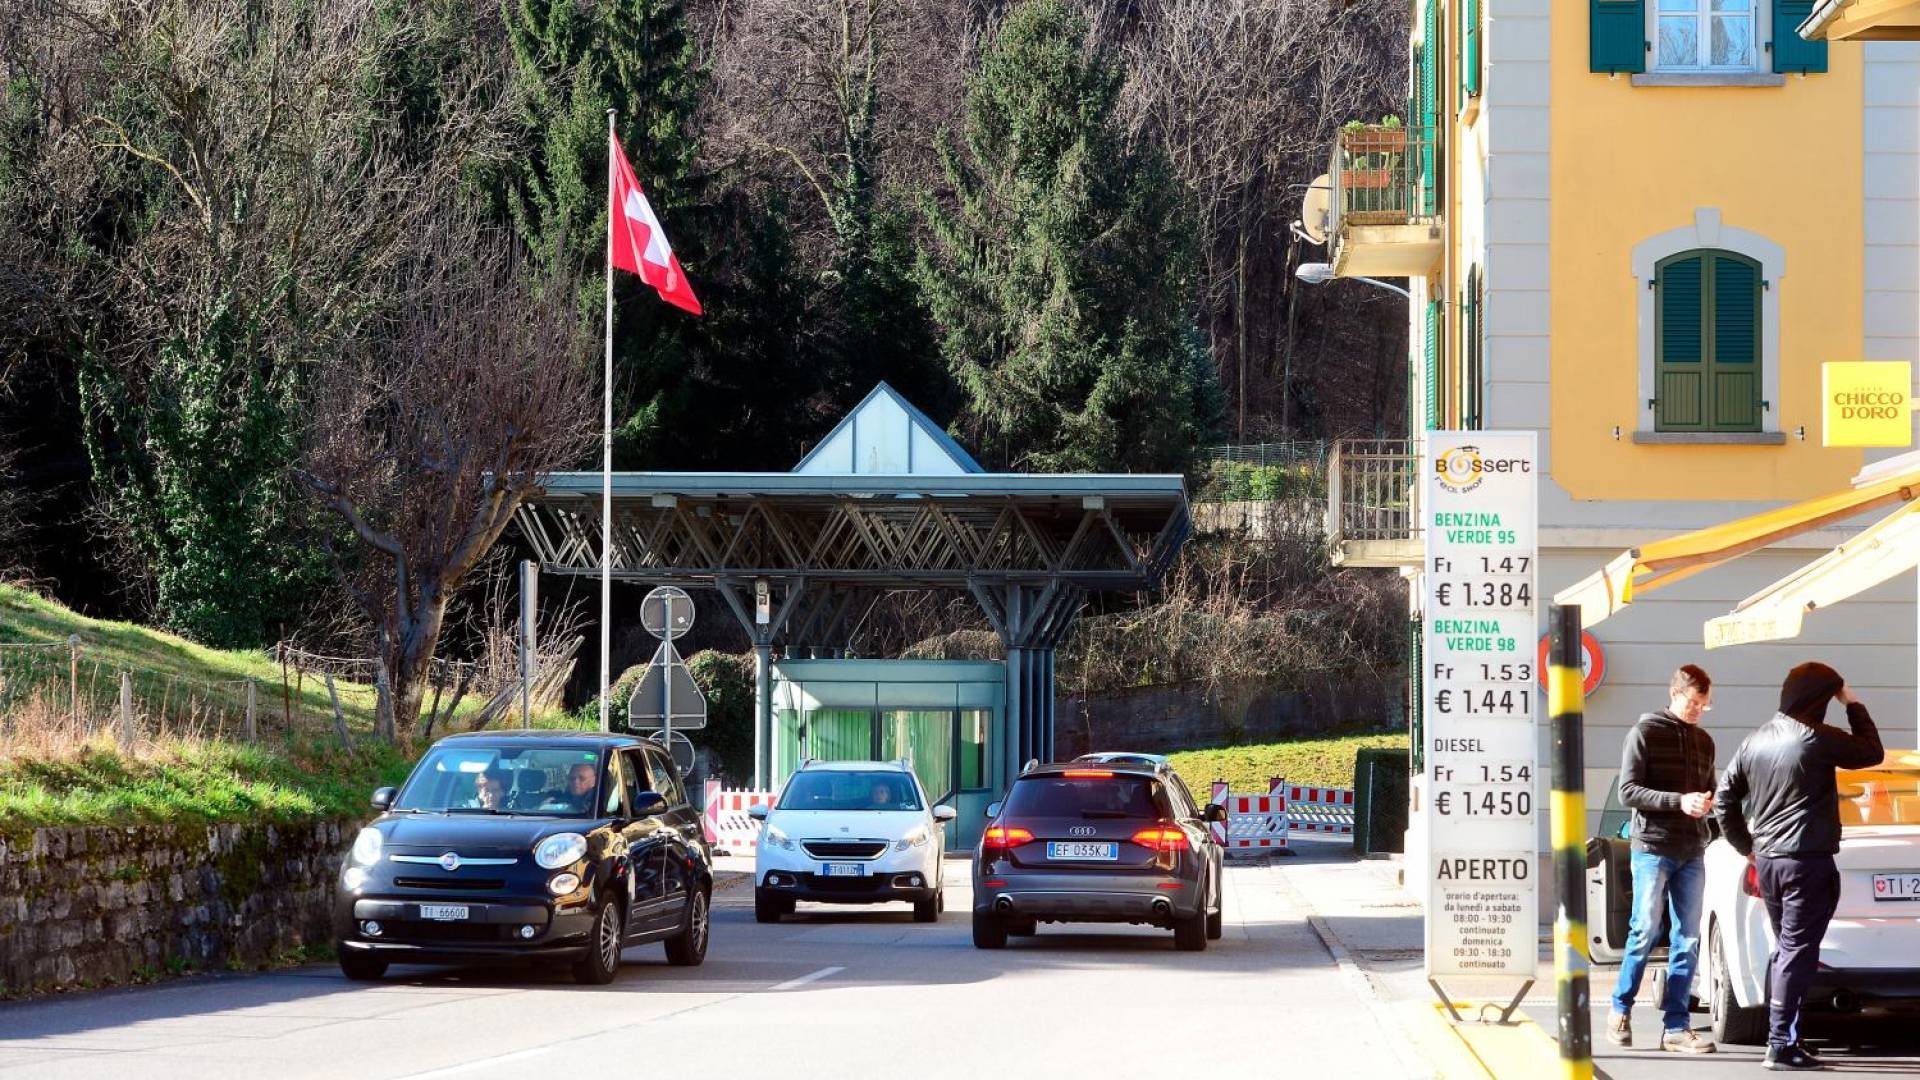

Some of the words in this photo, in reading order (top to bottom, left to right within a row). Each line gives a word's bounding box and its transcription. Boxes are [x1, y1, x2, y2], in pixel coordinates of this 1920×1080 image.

[1834, 393, 1903, 405] CHICCO
[1436, 513, 1500, 526] BENZINA
[1448, 531, 1492, 543] VERDE
[1498, 531, 1515, 543] 95
[1435, 558, 1451, 572] Fr
[1481, 557, 1529, 572] 1.47
[1436, 583, 1451, 606] €
[1463, 583, 1531, 606] 1.384
[1435, 621, 1499, 633] BENZINA
[1447, 638, 1492, 650] VERDE
[1498, 638, 1515, 651] 98
[1435, 664, 1454, 678] Fr
[1481, 664, 1530, 680] 1.53
[1435, 690, 1451, 713] €
[1463, 690, 1529, 714] 1.441
[1435, 740, 1484, 752] DIESEL
[1435, 766, 1454, 781] Fr
[1481, 766, 1531, 782] 1.54
[1435, 792, 1451, 815] €
[1463, 792, 1531, 815] 1.450
[1056, 844, 1069, 855] EF
[1437, 859, 1528, 880] APERTO
[1446, 892, 1470, 900] orario
[1445, 903, 1454, 911] da
[1454, 914, 1479, 923] 08:00
[1488, 914, 1512, 923] 19:30
[1459, 926, 1505, 935] continuato
[1462, 937, 1502, 946] domenica
[1454, 948, 1479, 956] 09:30
[1488, 948, 1511, 957] 18:30
